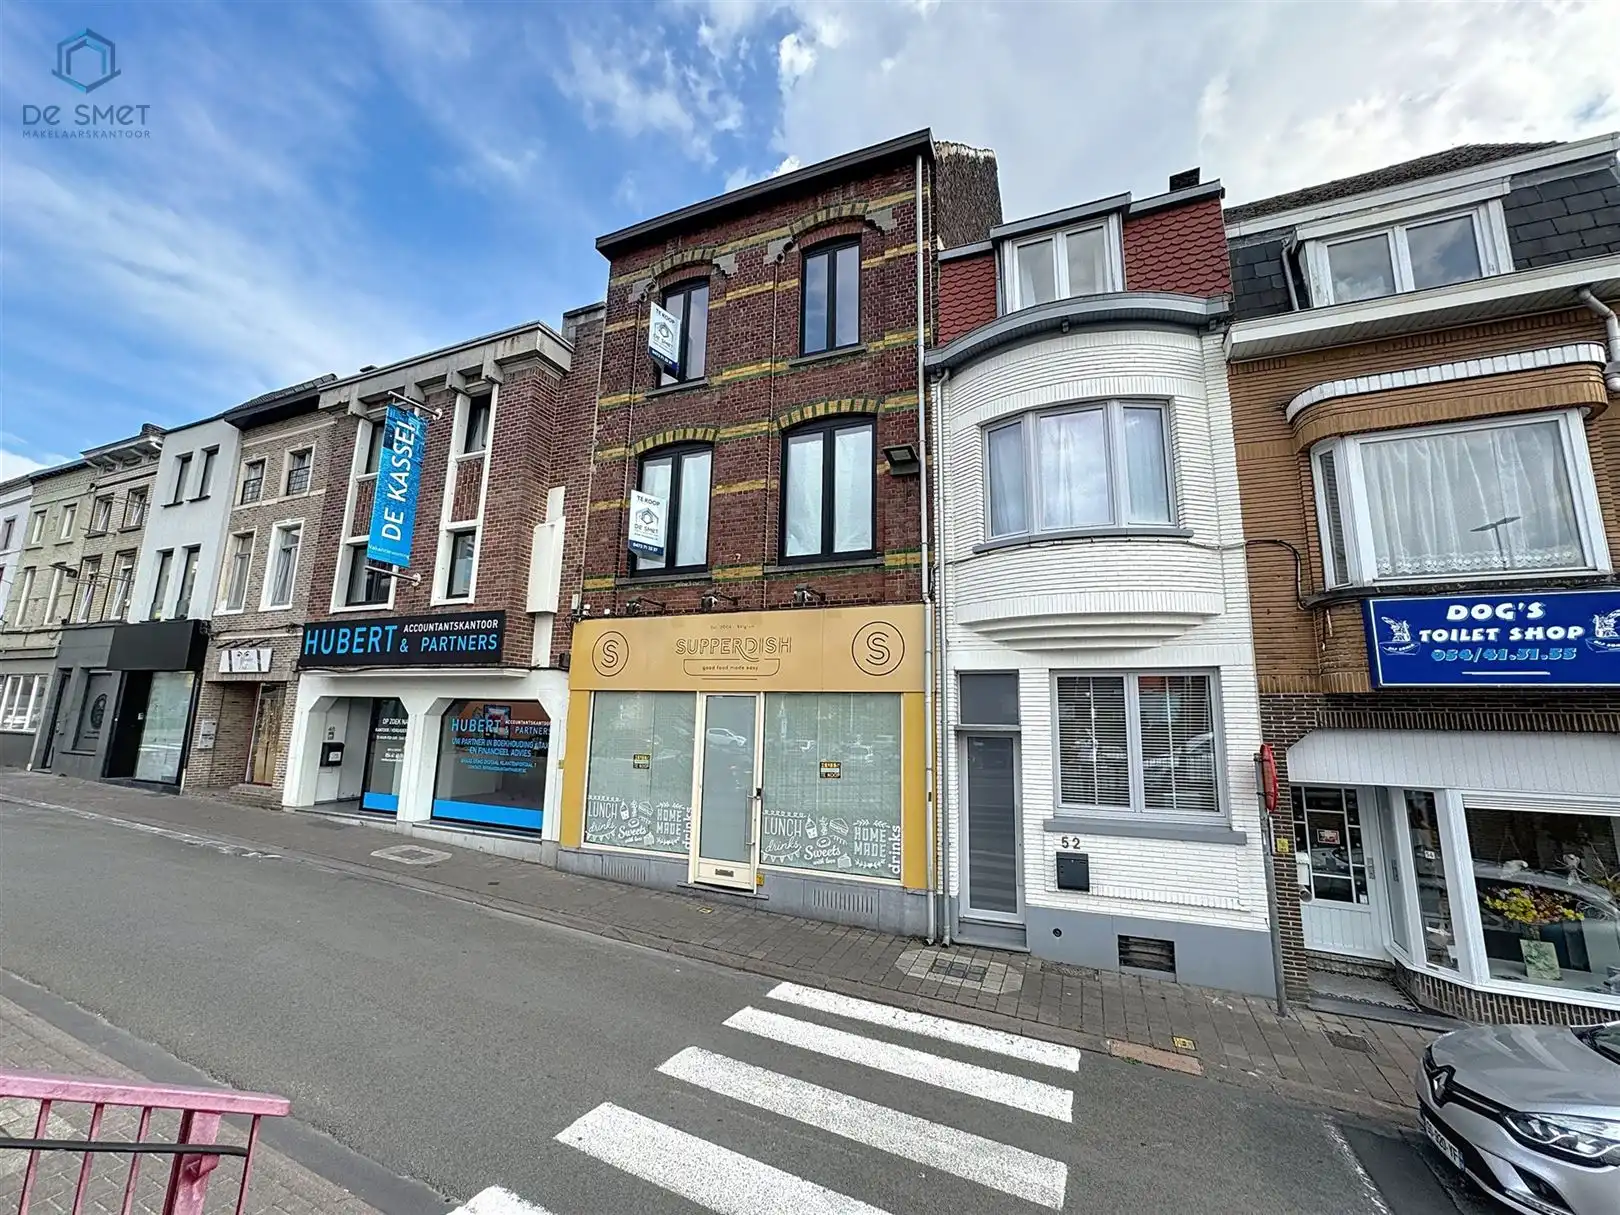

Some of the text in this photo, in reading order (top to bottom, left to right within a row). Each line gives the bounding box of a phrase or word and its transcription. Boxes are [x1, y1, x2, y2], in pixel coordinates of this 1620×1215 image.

[381, 507, 405, 542] DE
[1446, 601, 1546, 621] DOG'S
[403, 619, 499, 633] ACCOUNTANTSKANTOOR
[1419, 625, 1586, 644] TOILET SHOP
[304, 625, 398, 655] HUBERT
[400, 634, 498, 653] & PARTNERS
[675, 636, 792, 662] SUPPERDISH
[451, 718, 501, 733] HUBERT
[461, 737, 486, 746] PARTNER
[486, 738, 492, 746] IN
[588, 801, 618, 819] LUNCH
[657, 808, 682, 822] HOME
[618, 825, 647, 839] Sweets
[656, 821, 682, 835] MADE
[682, 807, 692, 850] drinks
[764, 816, 802, 837] LUNCH
[854, 826, 887, 843] HOME
[765, 836, 799, 852] drinks
[854, 841, 887, 858] MADE
[888, 825, 901, 874] drinks
[1061, 836, 1081, 850] 52
[803, 845, 841, 860] Sweets
